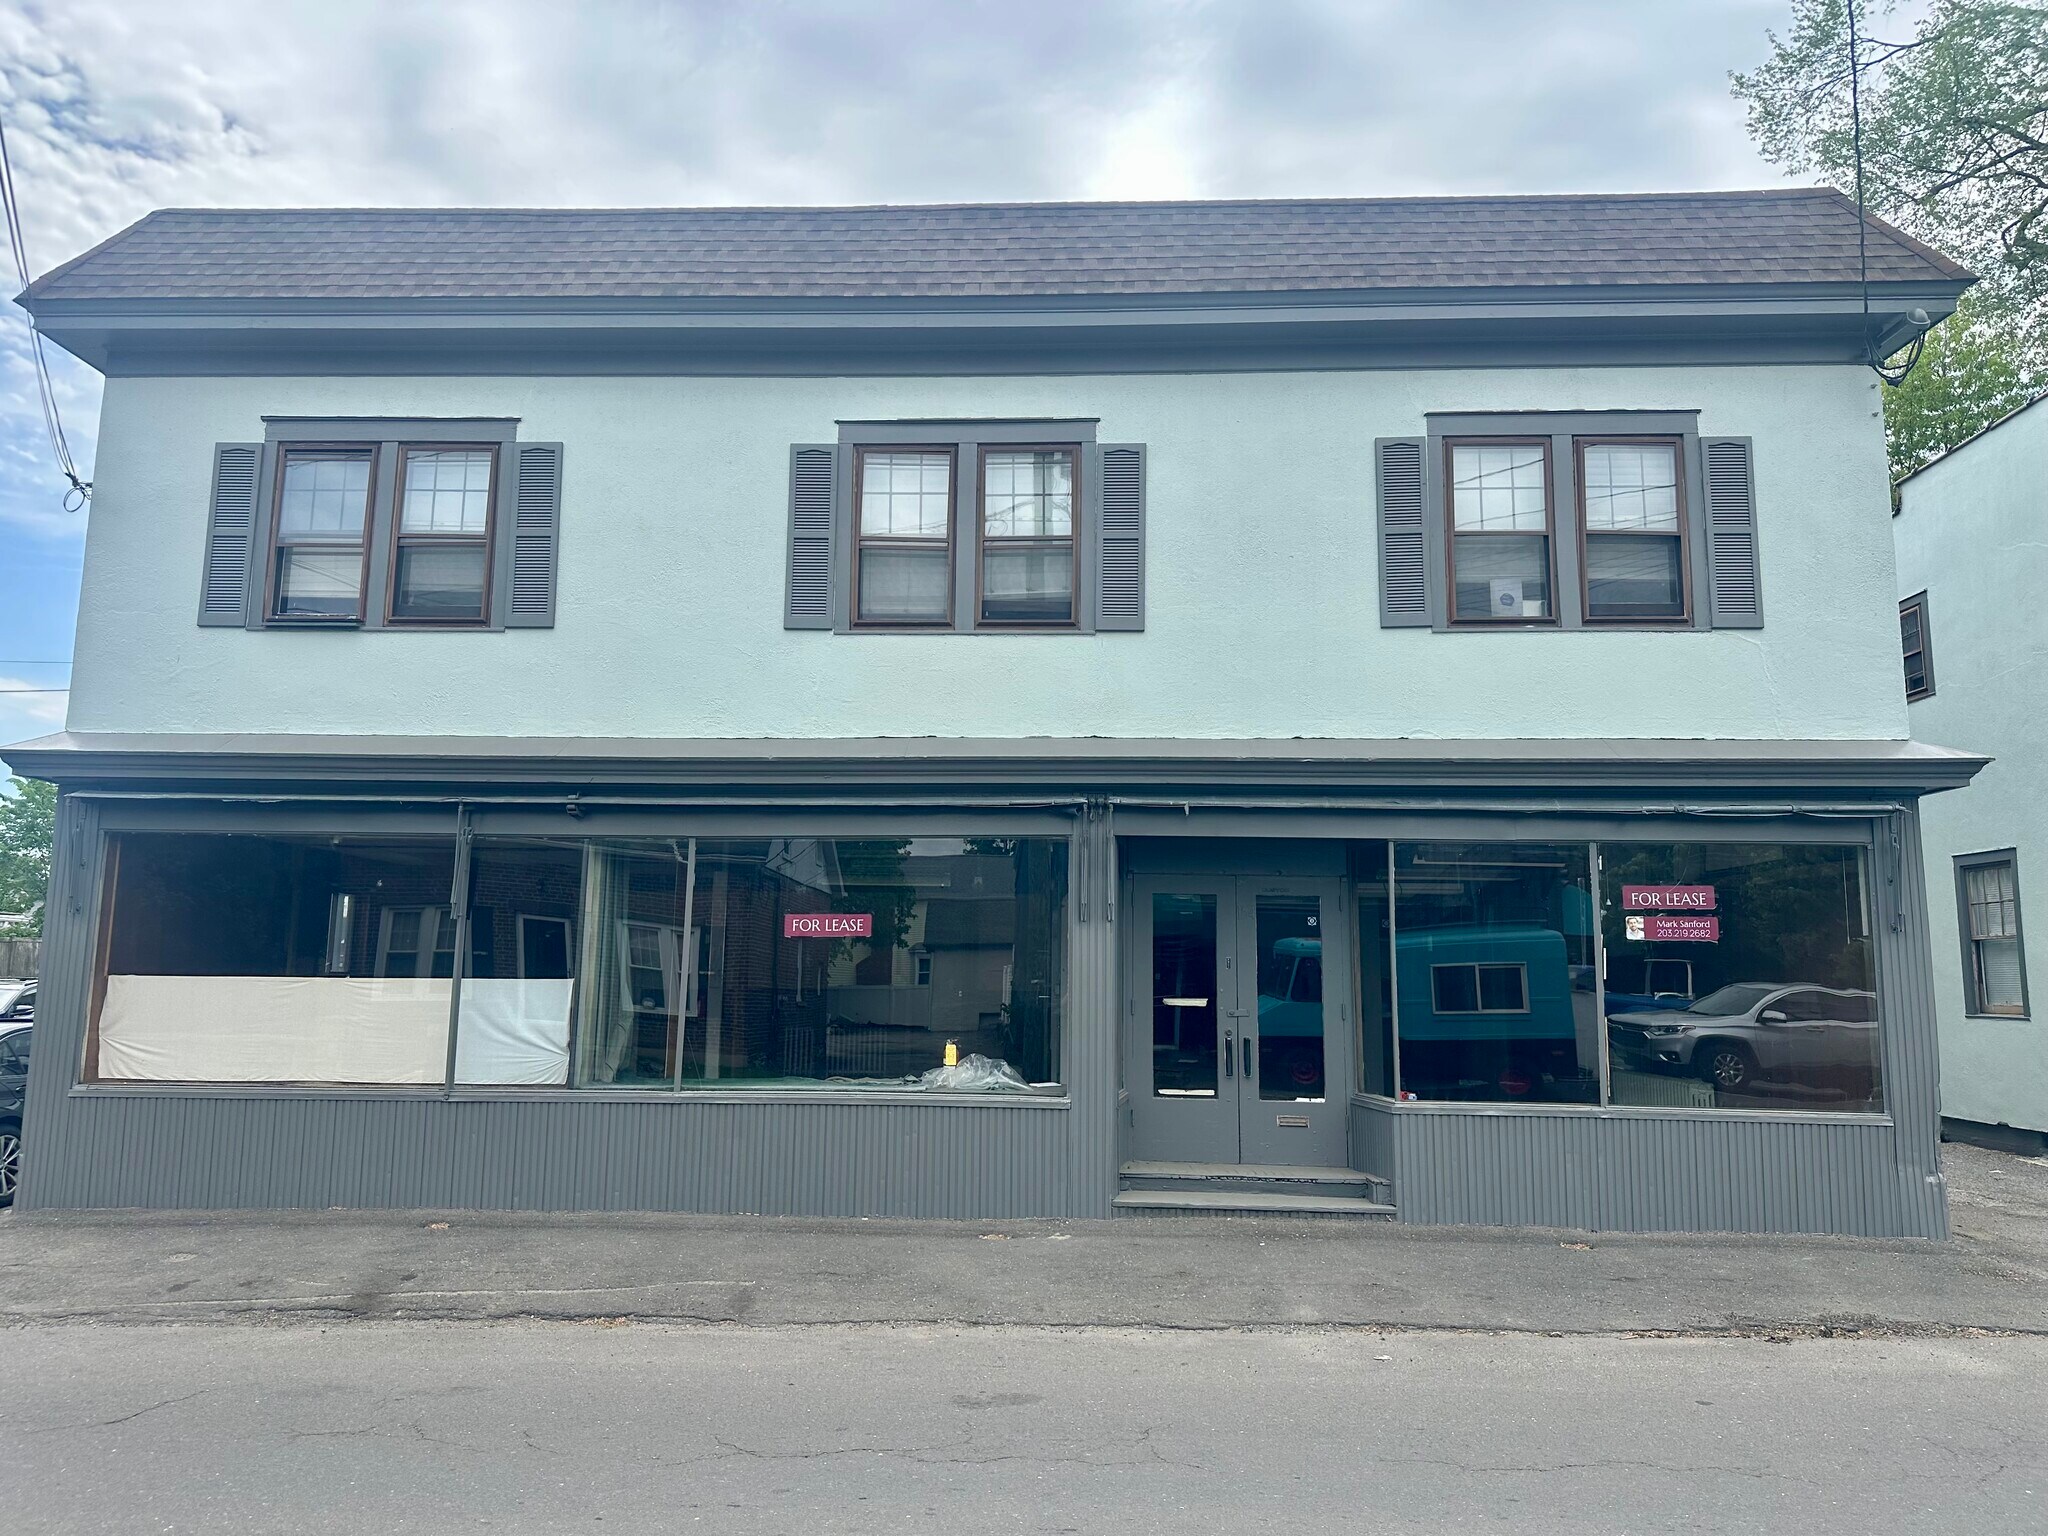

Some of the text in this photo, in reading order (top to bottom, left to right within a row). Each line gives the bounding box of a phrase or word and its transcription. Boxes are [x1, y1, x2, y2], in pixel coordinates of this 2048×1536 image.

[1631, 892, 1707, 906] FOR LEASE
[792, 918, 864, 932] FOR LEASE
[1656, 920, 1711, 928] Mark Sanford
[1657, 929, 1711, 938] 203.219.2682
